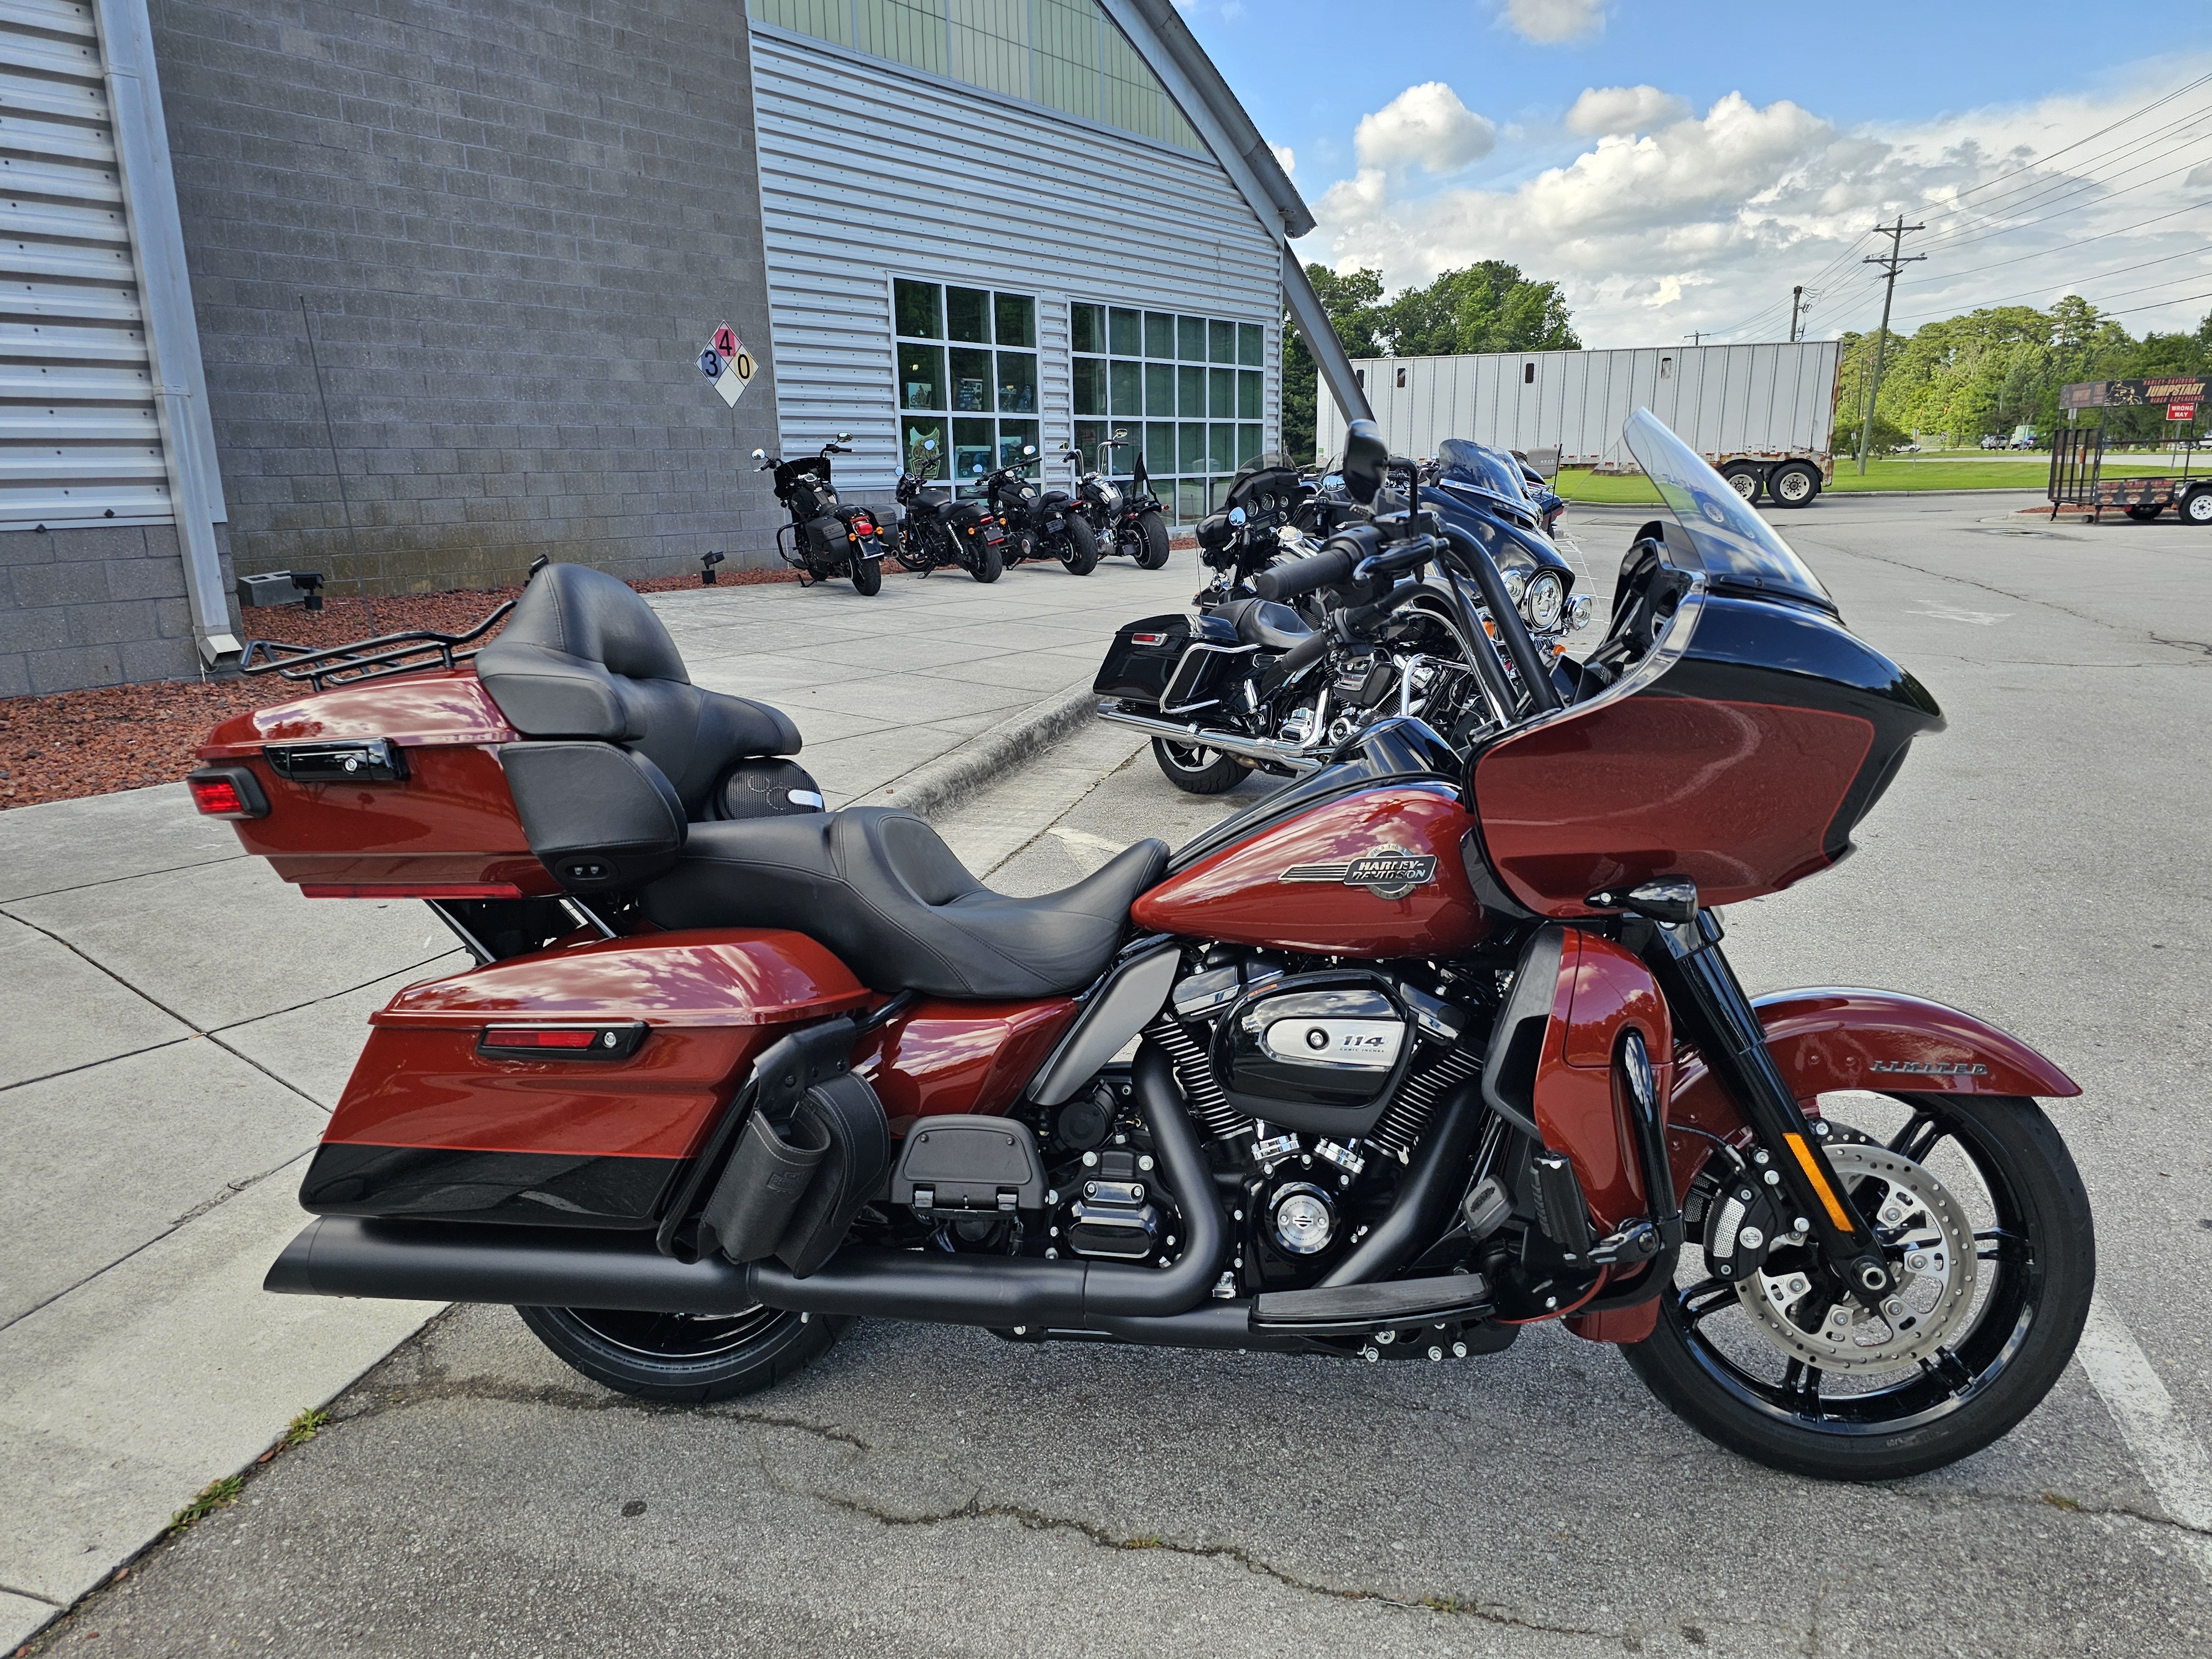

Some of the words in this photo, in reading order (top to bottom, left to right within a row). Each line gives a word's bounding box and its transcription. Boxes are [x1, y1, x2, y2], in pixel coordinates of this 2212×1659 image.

[719, 330, 732, 356] 4
[705, 351, 718, 377] 3
[738, 354, 750, 379] 0
[2145, 383, 2205, 397] JUMPSTART
[1359, 860, 1424, 870] HARLEY-
[1352, 870, 1426, 879] DAVIDSON
[1342, 1035, 1386, 1048] 114
[1874, 1061, 1987, 1074] LIMITED
